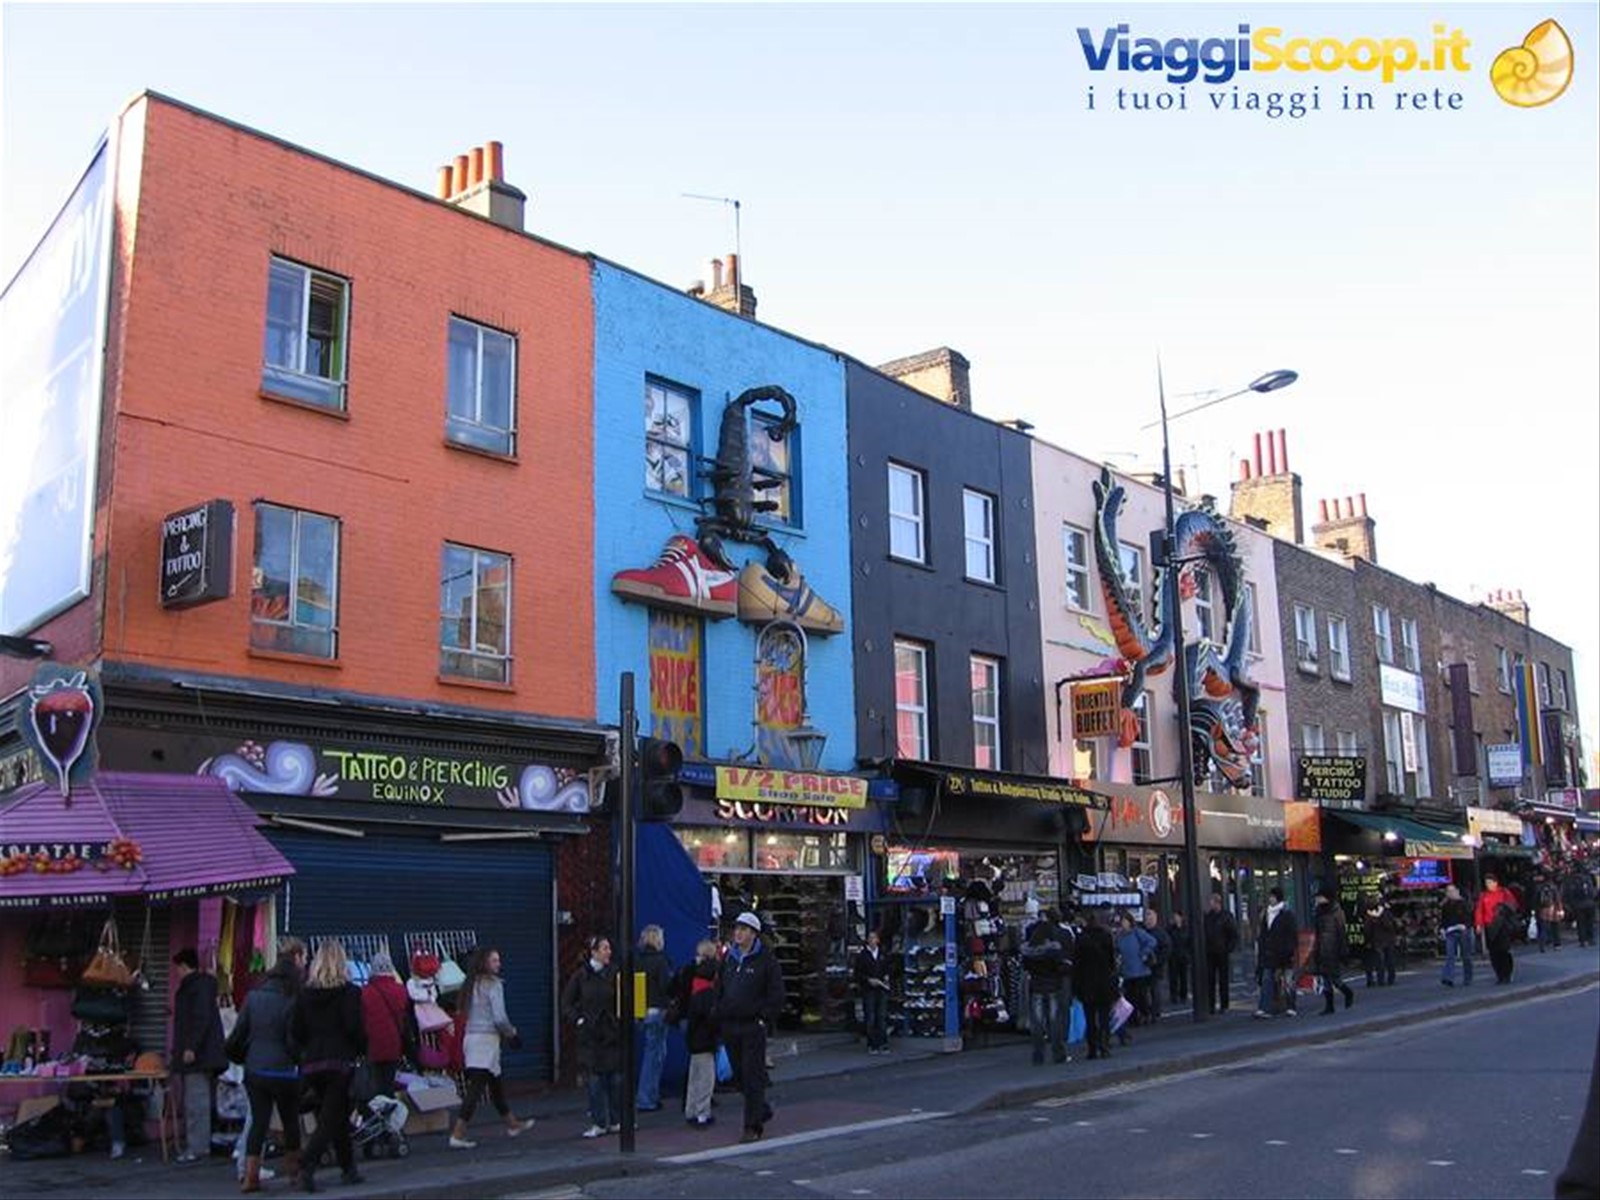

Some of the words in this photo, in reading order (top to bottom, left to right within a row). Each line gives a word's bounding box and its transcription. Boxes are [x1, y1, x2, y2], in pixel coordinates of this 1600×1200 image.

[167, 551, 201, 576] TATTOO
[1076, 710, 1115, 733] BUFFET
[408, 760, 418, 781] &
[1307, 766, 1355, 777] PIERCING
[724, 768, 775, 788] 1/2
[783, 773, 863, 796] PRICE
[1316, 778, 1361, 788] TATTOO
[373, 783, 445, 803] EQUINOX
[802, 793, 836, 803] Sale
[1311, 788, 1351, 798] STUDIO
